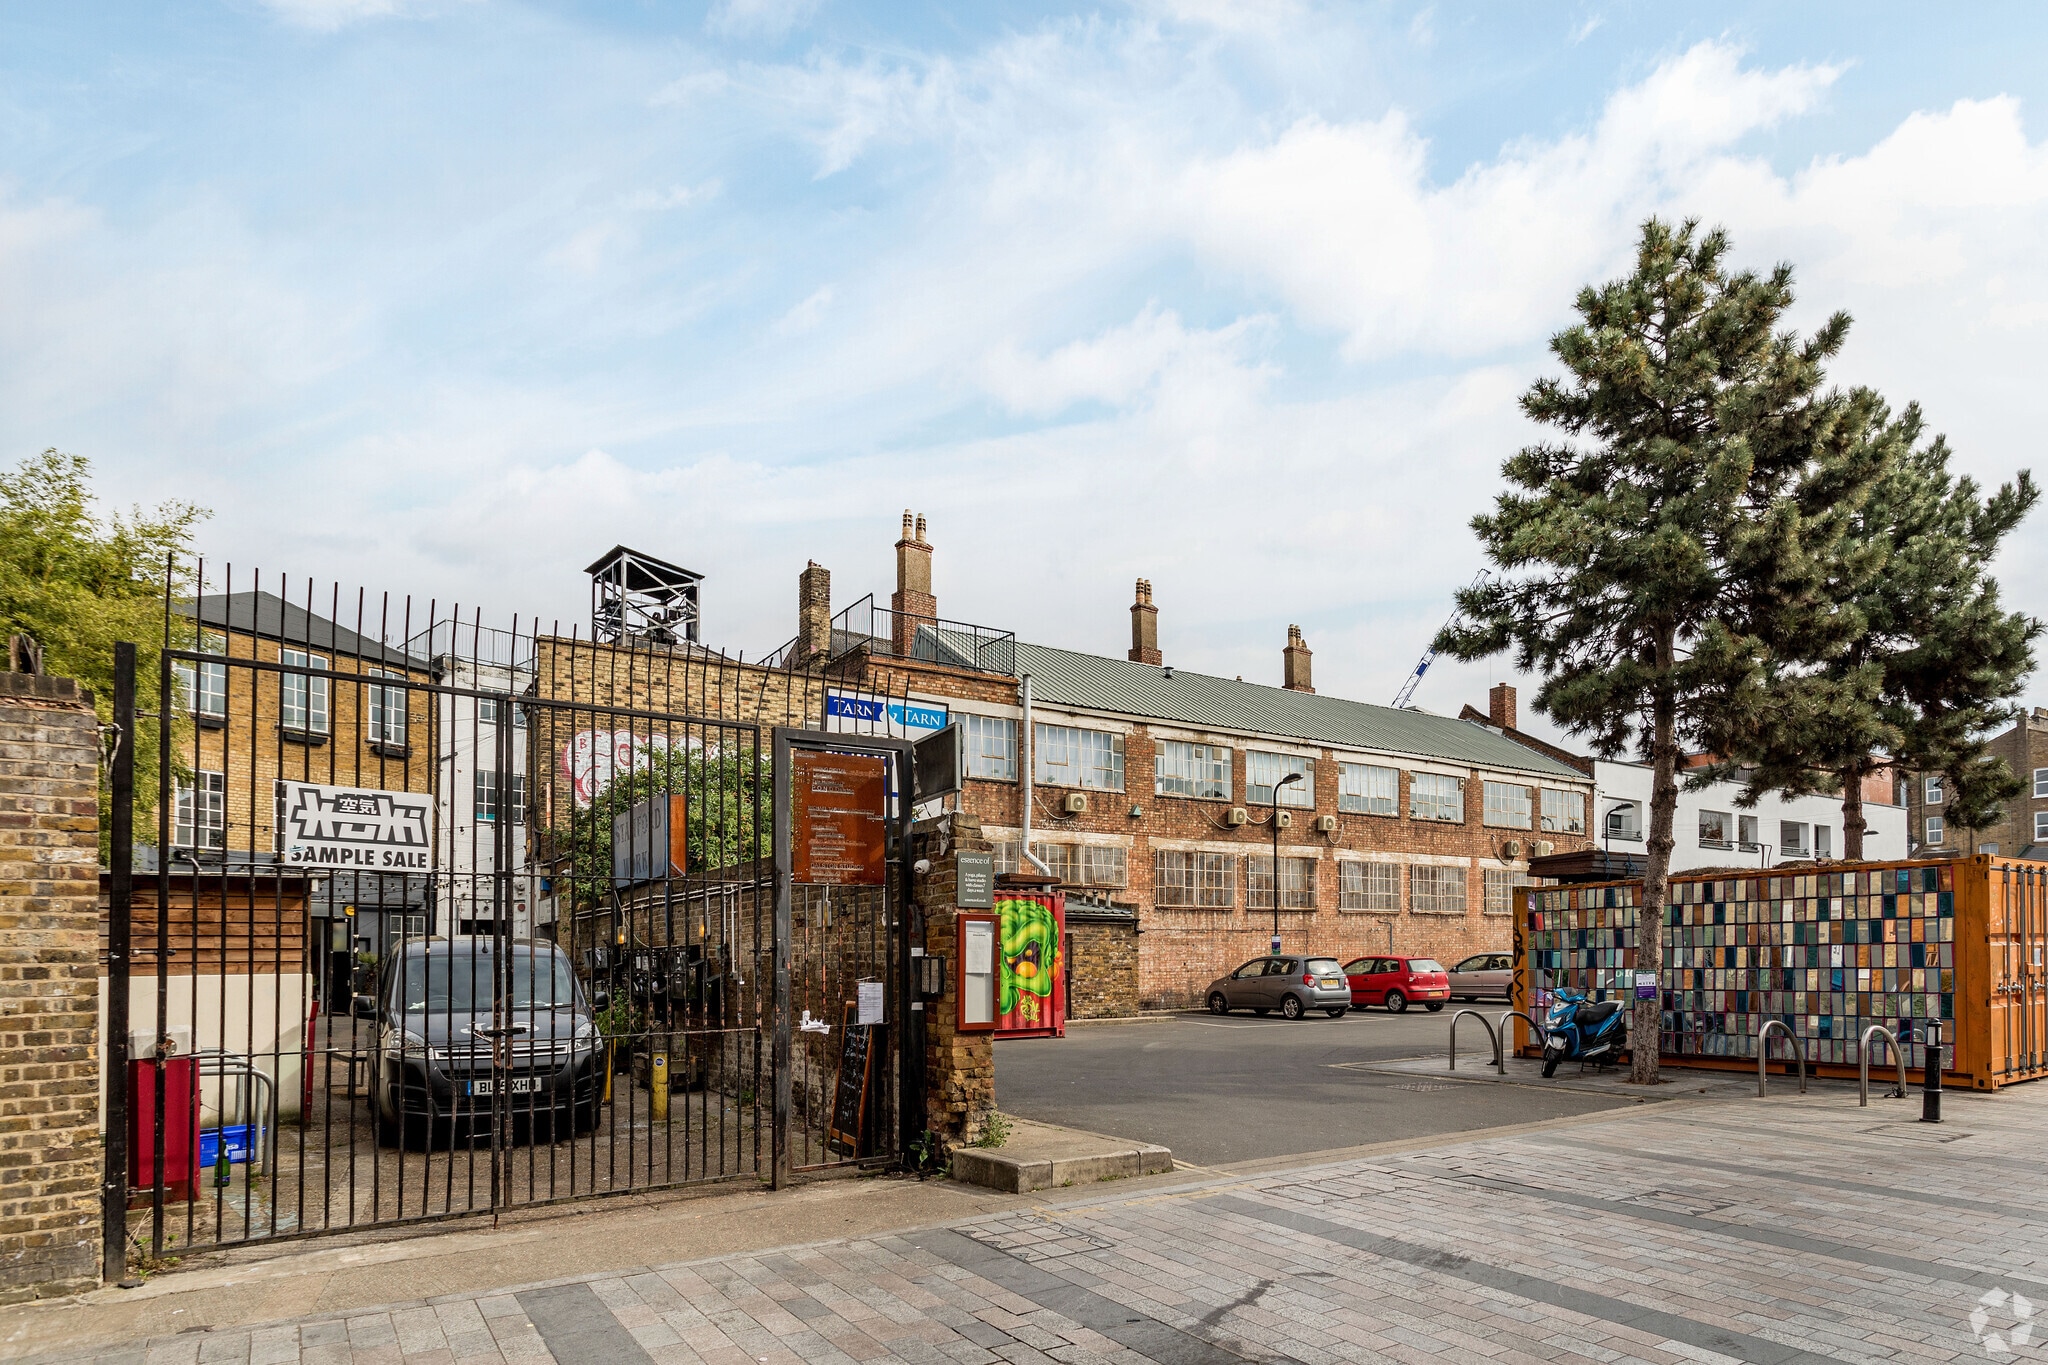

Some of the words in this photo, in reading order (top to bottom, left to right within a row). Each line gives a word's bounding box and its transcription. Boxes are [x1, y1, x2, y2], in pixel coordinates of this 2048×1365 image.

[833, 699, 876, 717] TARN
[902, 709, 941, 726] TARN
[339, 797, 377, 815] 空気
[614, 808, 661, 844] STAFOD
[290, 846, 376, 866] SAMPLE
[382, 850, 427, 869] SALE
